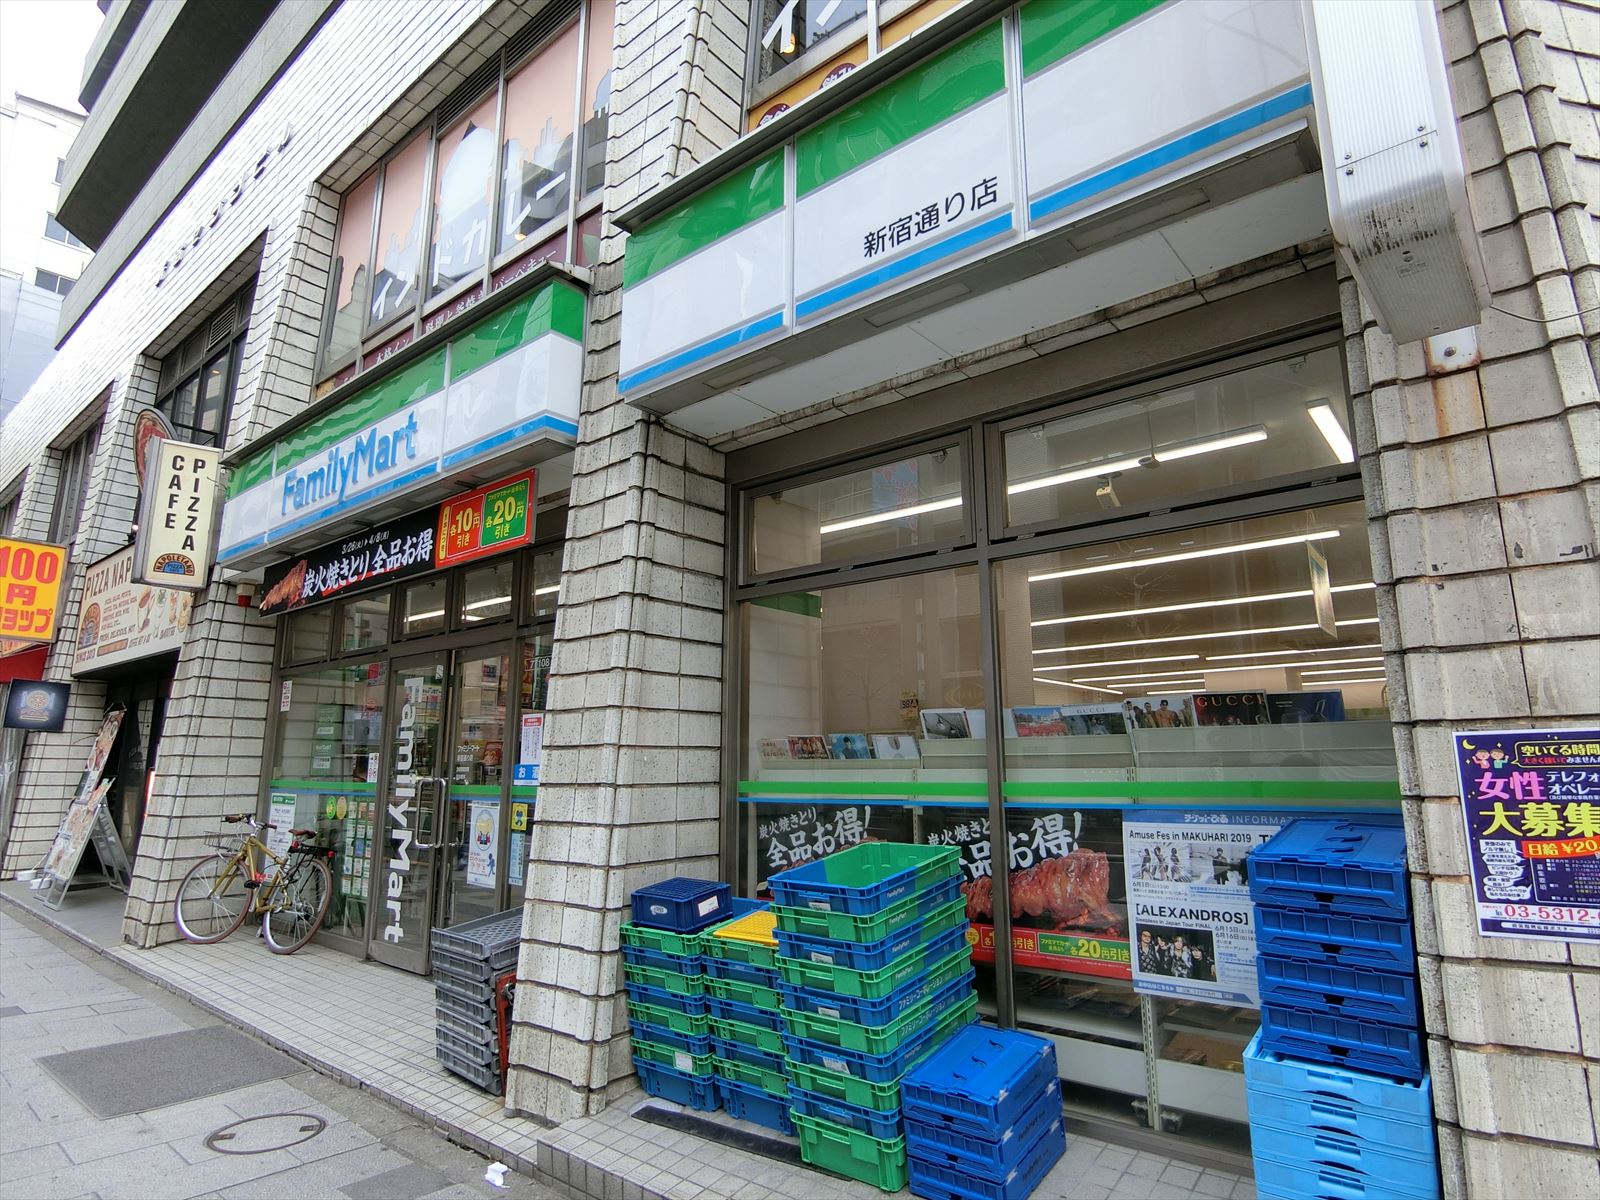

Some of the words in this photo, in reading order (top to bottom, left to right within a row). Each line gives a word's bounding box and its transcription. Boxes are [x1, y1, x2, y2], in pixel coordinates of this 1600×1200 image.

[863, 176, 998, 258] 新宿通り店
[372, 172, 566, 321] インドカレー
[281, 410, 418, 516] FamilyMart
[165, 455, 185, 529] CAFE
[181, 458, 206, 551] PIZZA
[457, 533, 470, 549] 引き
[495, 523, 510, 539] 引き
[0, 546, 59, 584] 100
[155, 554, 193, 574] NAPOLETANO
[302, 549, 370, 600] 炭火焼きとり
[371, 528, 434, 576] 全品お得
[85, 568, 109, 600] PIZZA
[112, 556, 132, 589] NAP
[6, 583, 37, 606] 円
[0, 608, 53, 633] ョップ
[1197, 694, 1265, 707] GUCCI
[1475, 771, 1547, 800] 女性
[1546, 771, 1600, 783] テレフォ
[1548, 783, 1600, 795] オペレー
[383, 676, 424, 944] FamilyMart
[1184, 813, 1229, 824] チケットぴあ
[1232, 815, 1306, 826] INFORMAT
[1479, 802, 1600, 838] 大募集
[760, 806, 817, 839] 炭火焼きとり
[927, 817, 991, 846] 炭火焼きと
[766, 805, 871, 868] 全品お得!
[958, 811, 1083, 882] 品お得!
[1129, 829, 1155, 839] Amuse
[1156, 831, 1170, 840] Fes
[1172, 831, 1180, 840] in
[1181, 832, 1229, 842] MAKUHARI
[1231, 833, 1252, 843] 2019
[1528, 843, 1559, 857] 日給
[1561, 839, 1600, 855] ¥20
[886, 886, 905, 898] FamilyMart
[888, 911, 907, 925] FamilyMart
[1136, 903, 1249, 925] [ALEXANDROS]
[1505, 904, 1600, 922] 03-5312-
[891, 939, 910, 953] FamilyMart
[1069, 939, 1130, 961] 各20円引き
[895, 965, 913, 980] FamilyMart
